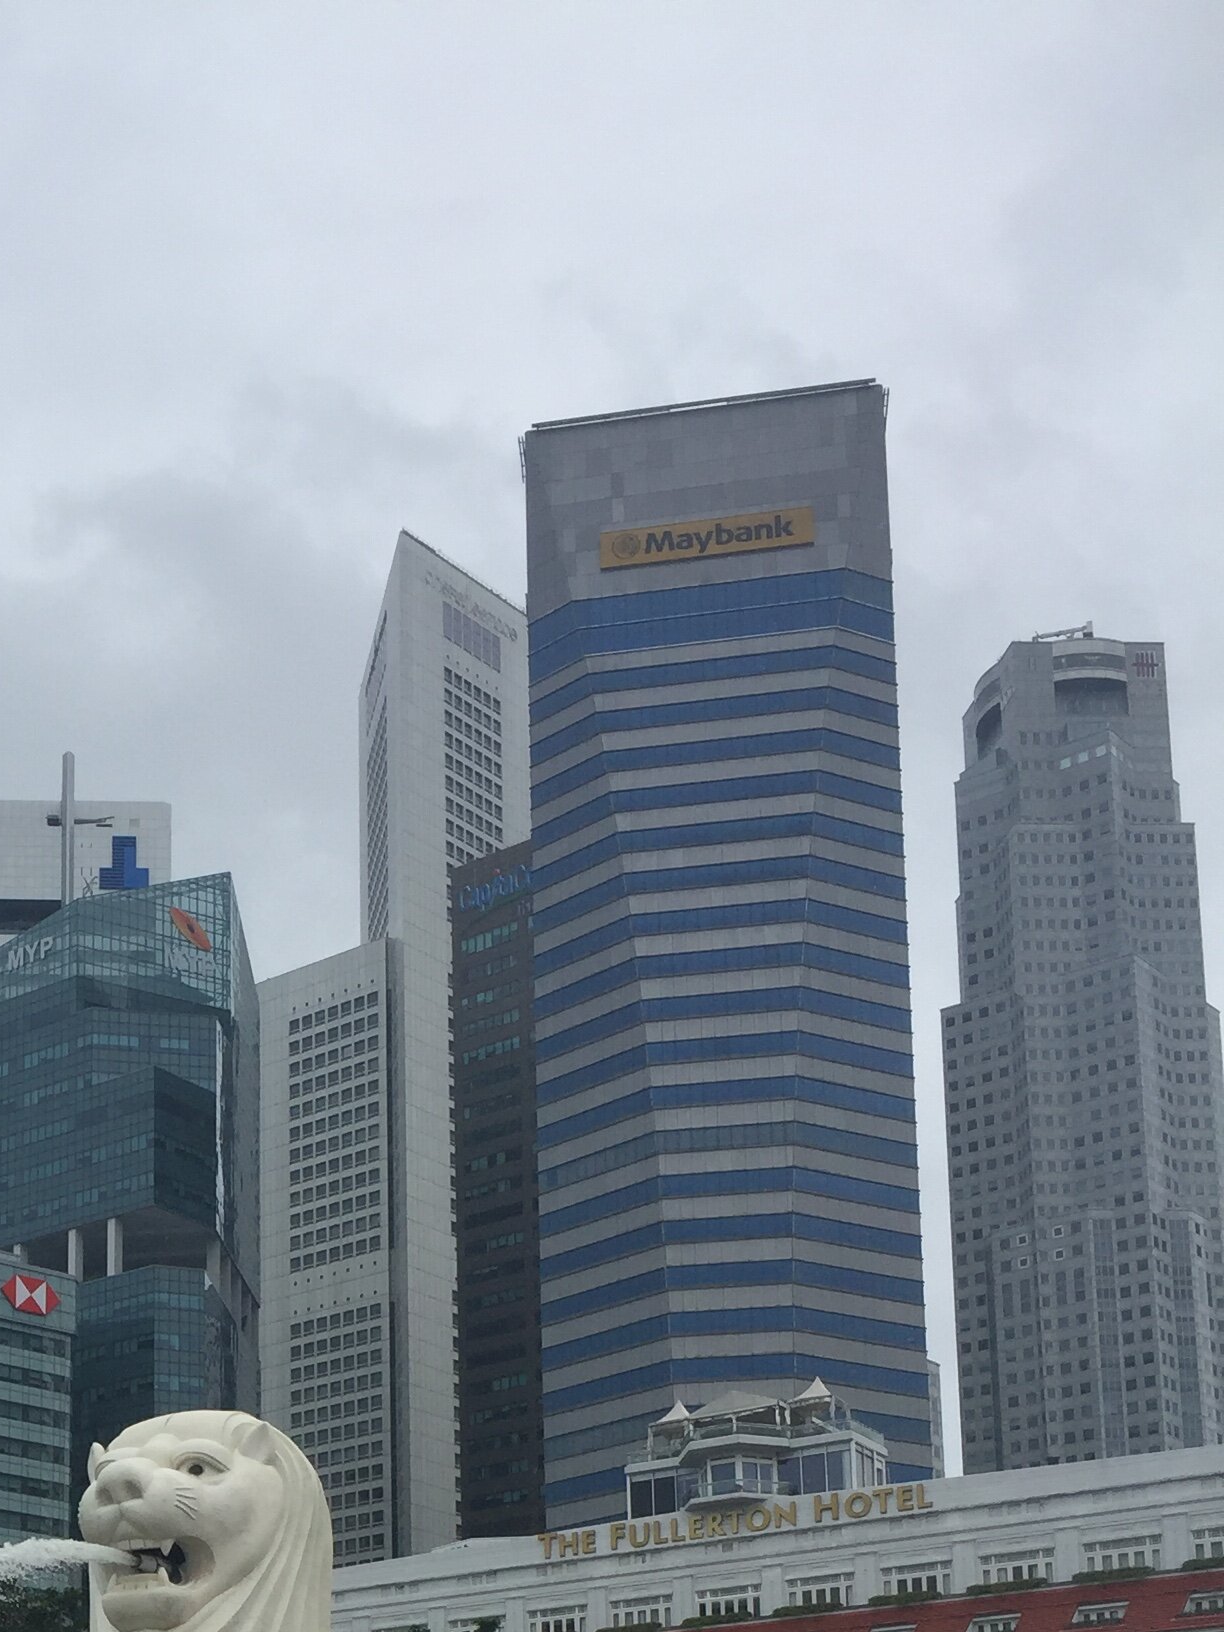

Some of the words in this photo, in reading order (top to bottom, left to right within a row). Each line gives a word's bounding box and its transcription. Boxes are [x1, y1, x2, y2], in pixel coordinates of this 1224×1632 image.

[644, 515, 794, 554] Maybank
[6, 936, 54, 972] MYP
[537, 1529, 596, 1560] THE
[610, 1500, 797, 1551] FULLERTON
[814, 1483, 933, 1523] HOTEL
